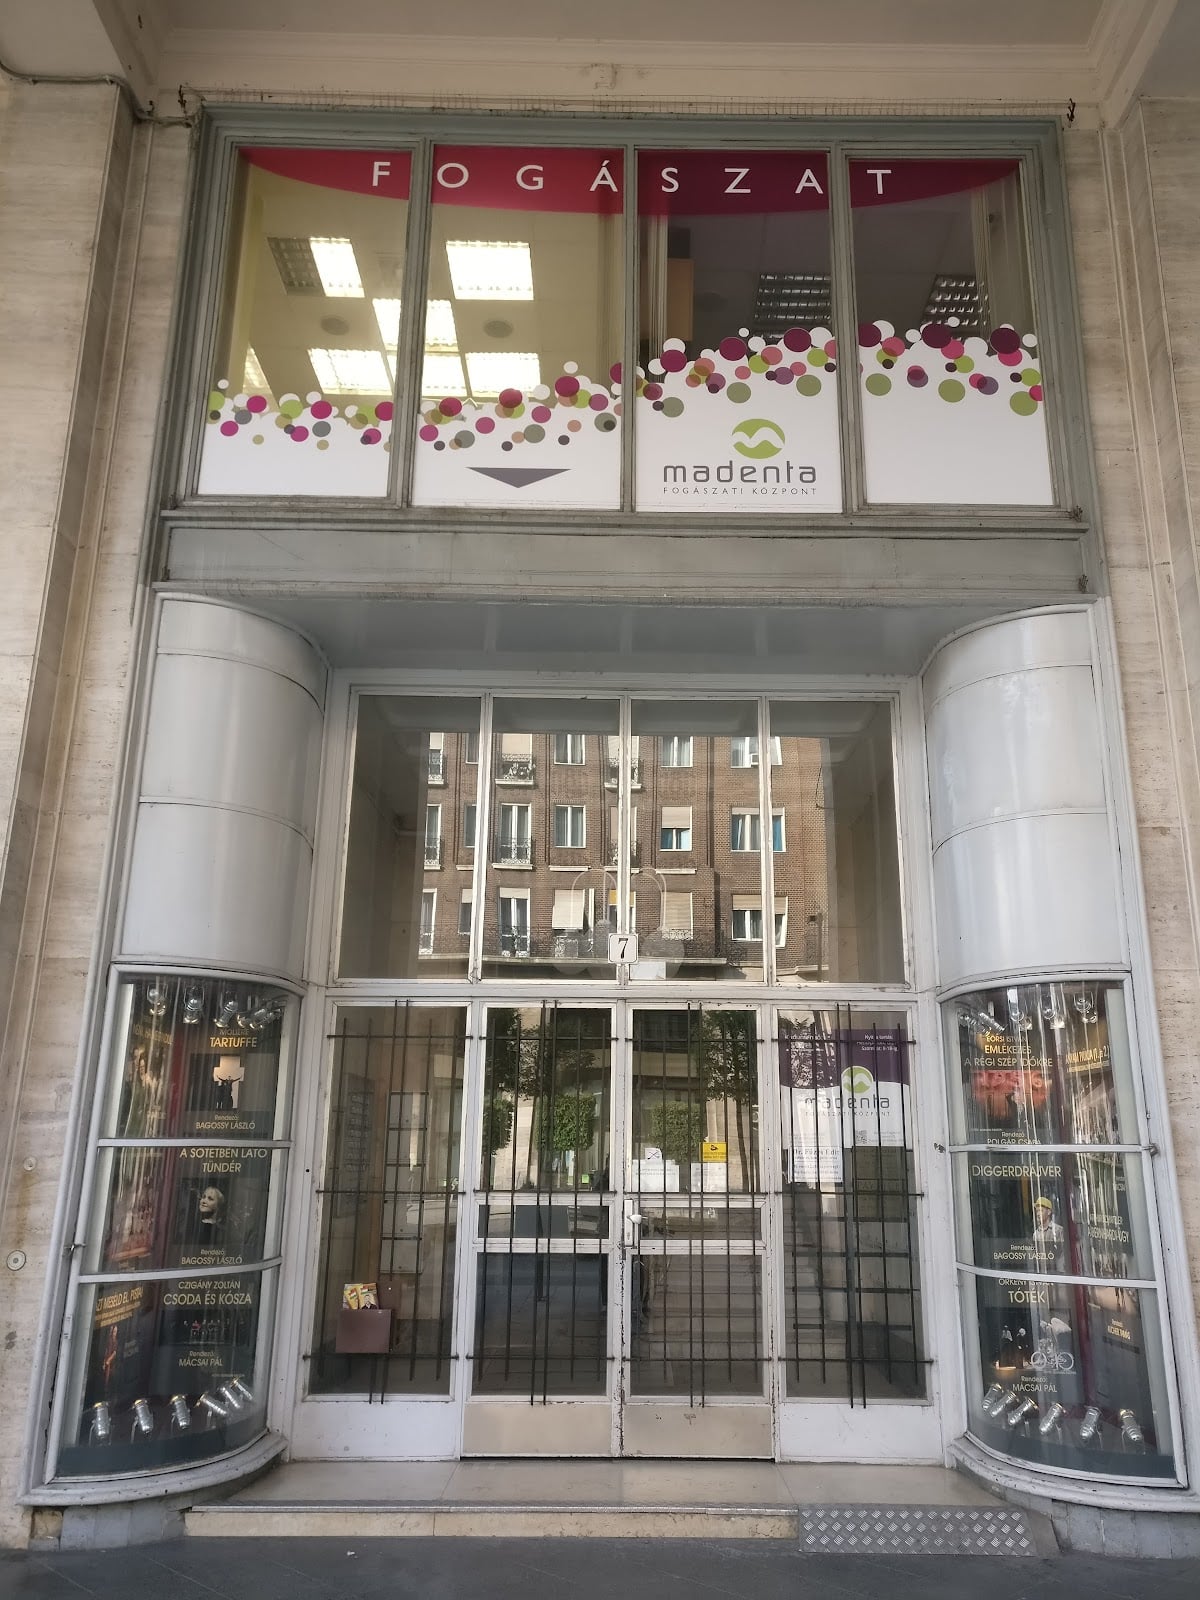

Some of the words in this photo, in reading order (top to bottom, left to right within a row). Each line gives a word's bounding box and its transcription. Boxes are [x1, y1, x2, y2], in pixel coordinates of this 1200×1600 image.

[372, 160, 892, 195] FOGÁSZAT
[663, 460, 817, 483] madenta
[663, 486, 744, 495] FOGÁSZATI
[752, 486, 817, 495] KÖZPONT
[618, 937, 629, 959] 7
[209, 1037, 258, 1048] TARTUFFE
[974, 1057, 996, 1066] RÉGI
[997, 1057, 1017, 1066] SZÉP
[195, 1122, 229, 1130] BAGOSSY
[230, 1120, 256, 1130] LÁSZLÓ
[180, 1148, 188, 1158] A
[202, 1160, 242, 1173] TÜNDÉR
[972, 1162, 1062, 1177] DIGGERDRÁJVER
[181, 1256, 215, 1265] BAGOSSY
[216, 1254, 243, 1265] LÁSZLÓ
[993, 1252, 1026, 1260] BAGOSSY
[178, 1280, 212, 1290] CZIGÁNY
[213, 1280, 241, 1290] ZOLTÁN
[163, 1293, 201, 1305] CSODA
[204, 1291, 216, 1305] ÉS
[218, 1291, 252, 1305] KÓSZA
[1008, 1287, 1046, 1303] TÓTÉK
[178, 1356, 209, 1367] MÁCSAI
[210, 1356, 223, 1367] PÁL
[1012, 1381, 1042, 1392] MÁCSAI
[1043, 1381, 1058, 1393] PÁL
